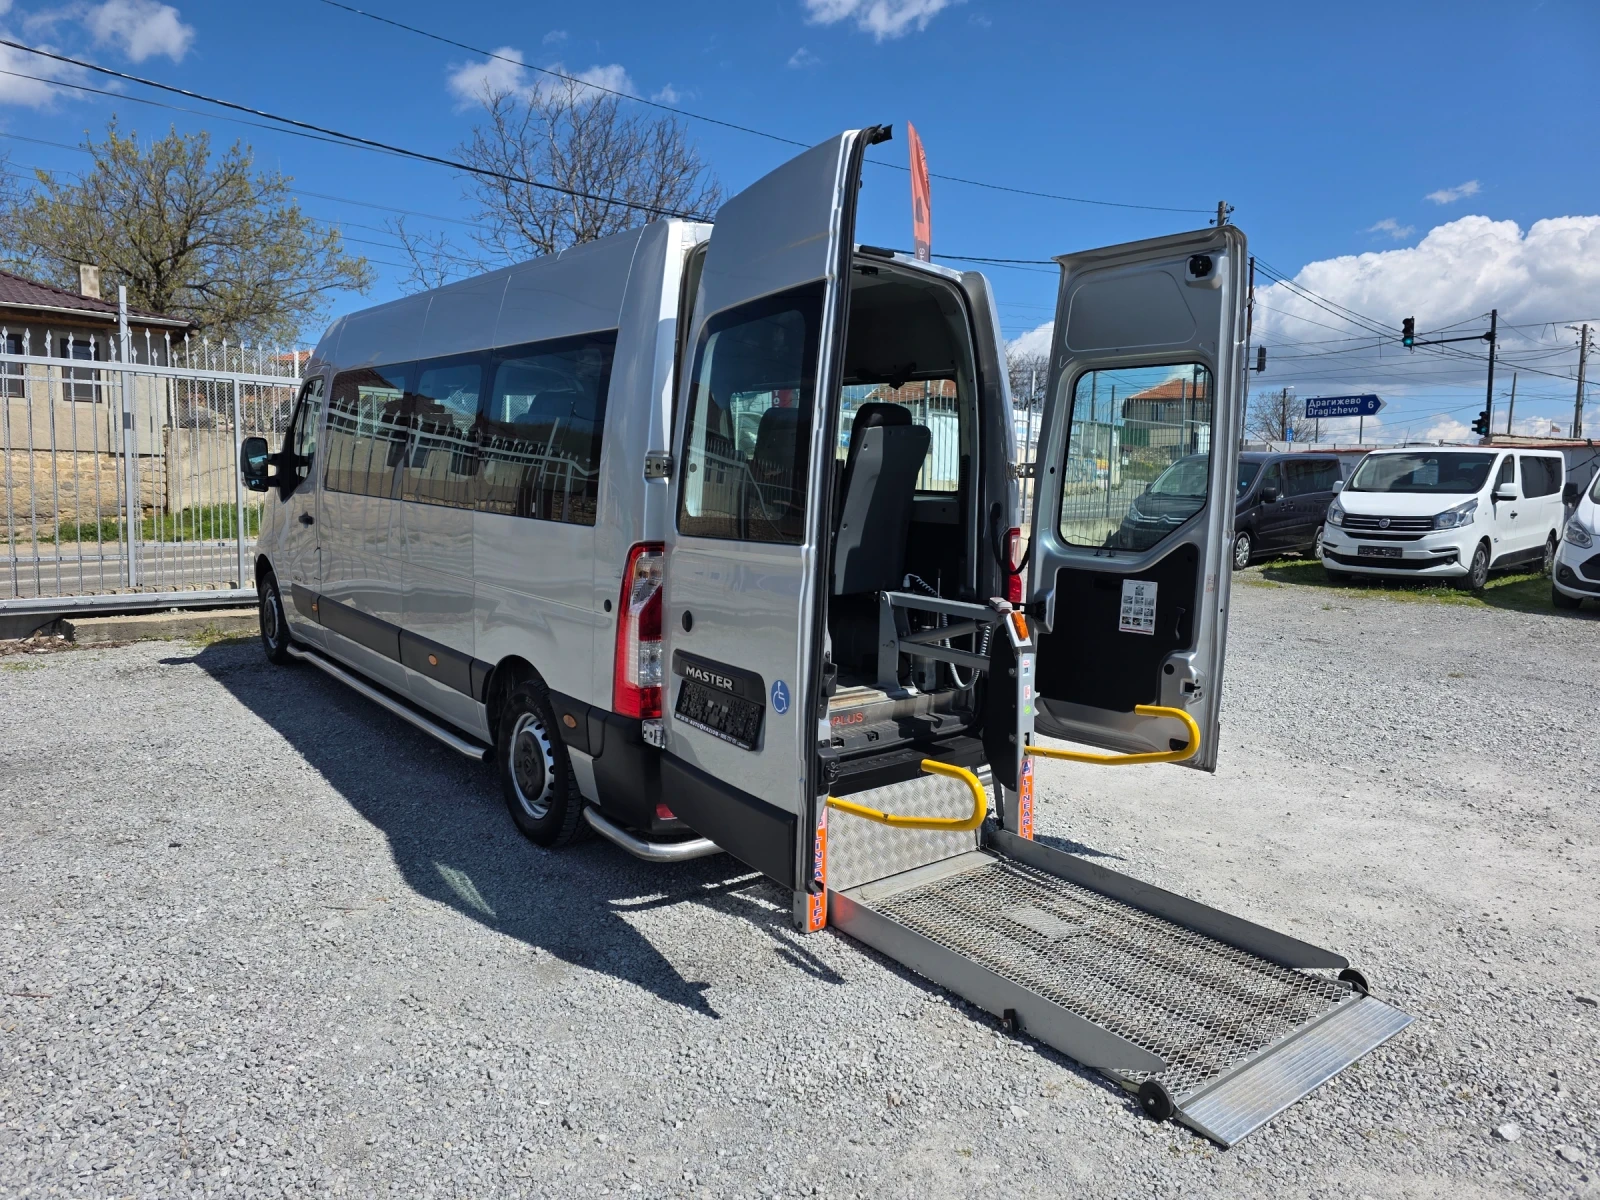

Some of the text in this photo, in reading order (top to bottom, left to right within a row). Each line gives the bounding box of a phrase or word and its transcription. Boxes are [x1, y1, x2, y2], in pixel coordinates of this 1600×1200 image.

[1308, 398, 1361, 408] Драгижево
[1368, 401, 1374, 409] 6
[1308, 407, 1359, 416] Dragizhevo
[686, 665, 733, 691] MASTER
[831, 711, 864, 727] PLUS
